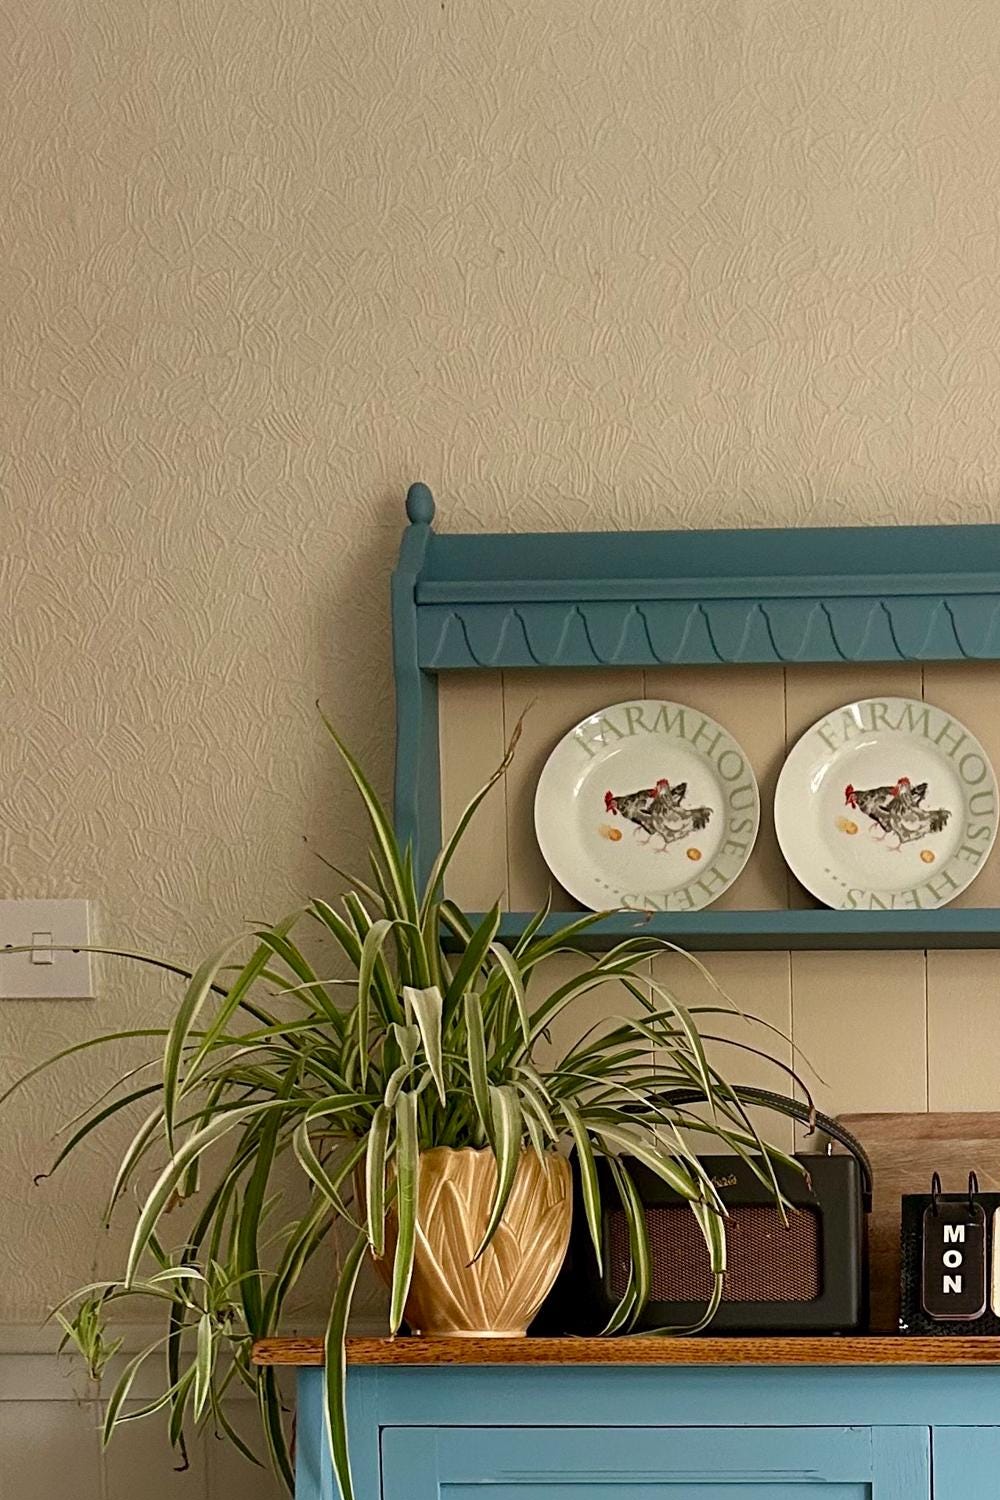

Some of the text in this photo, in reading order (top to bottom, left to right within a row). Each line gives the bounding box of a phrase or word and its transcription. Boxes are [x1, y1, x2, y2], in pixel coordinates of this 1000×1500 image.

[573, 704, 755, 859] FARMHOUSE
[816, 702, 994, 866] FARMHOUSE
[942, 1224, 966, 1294] MON
